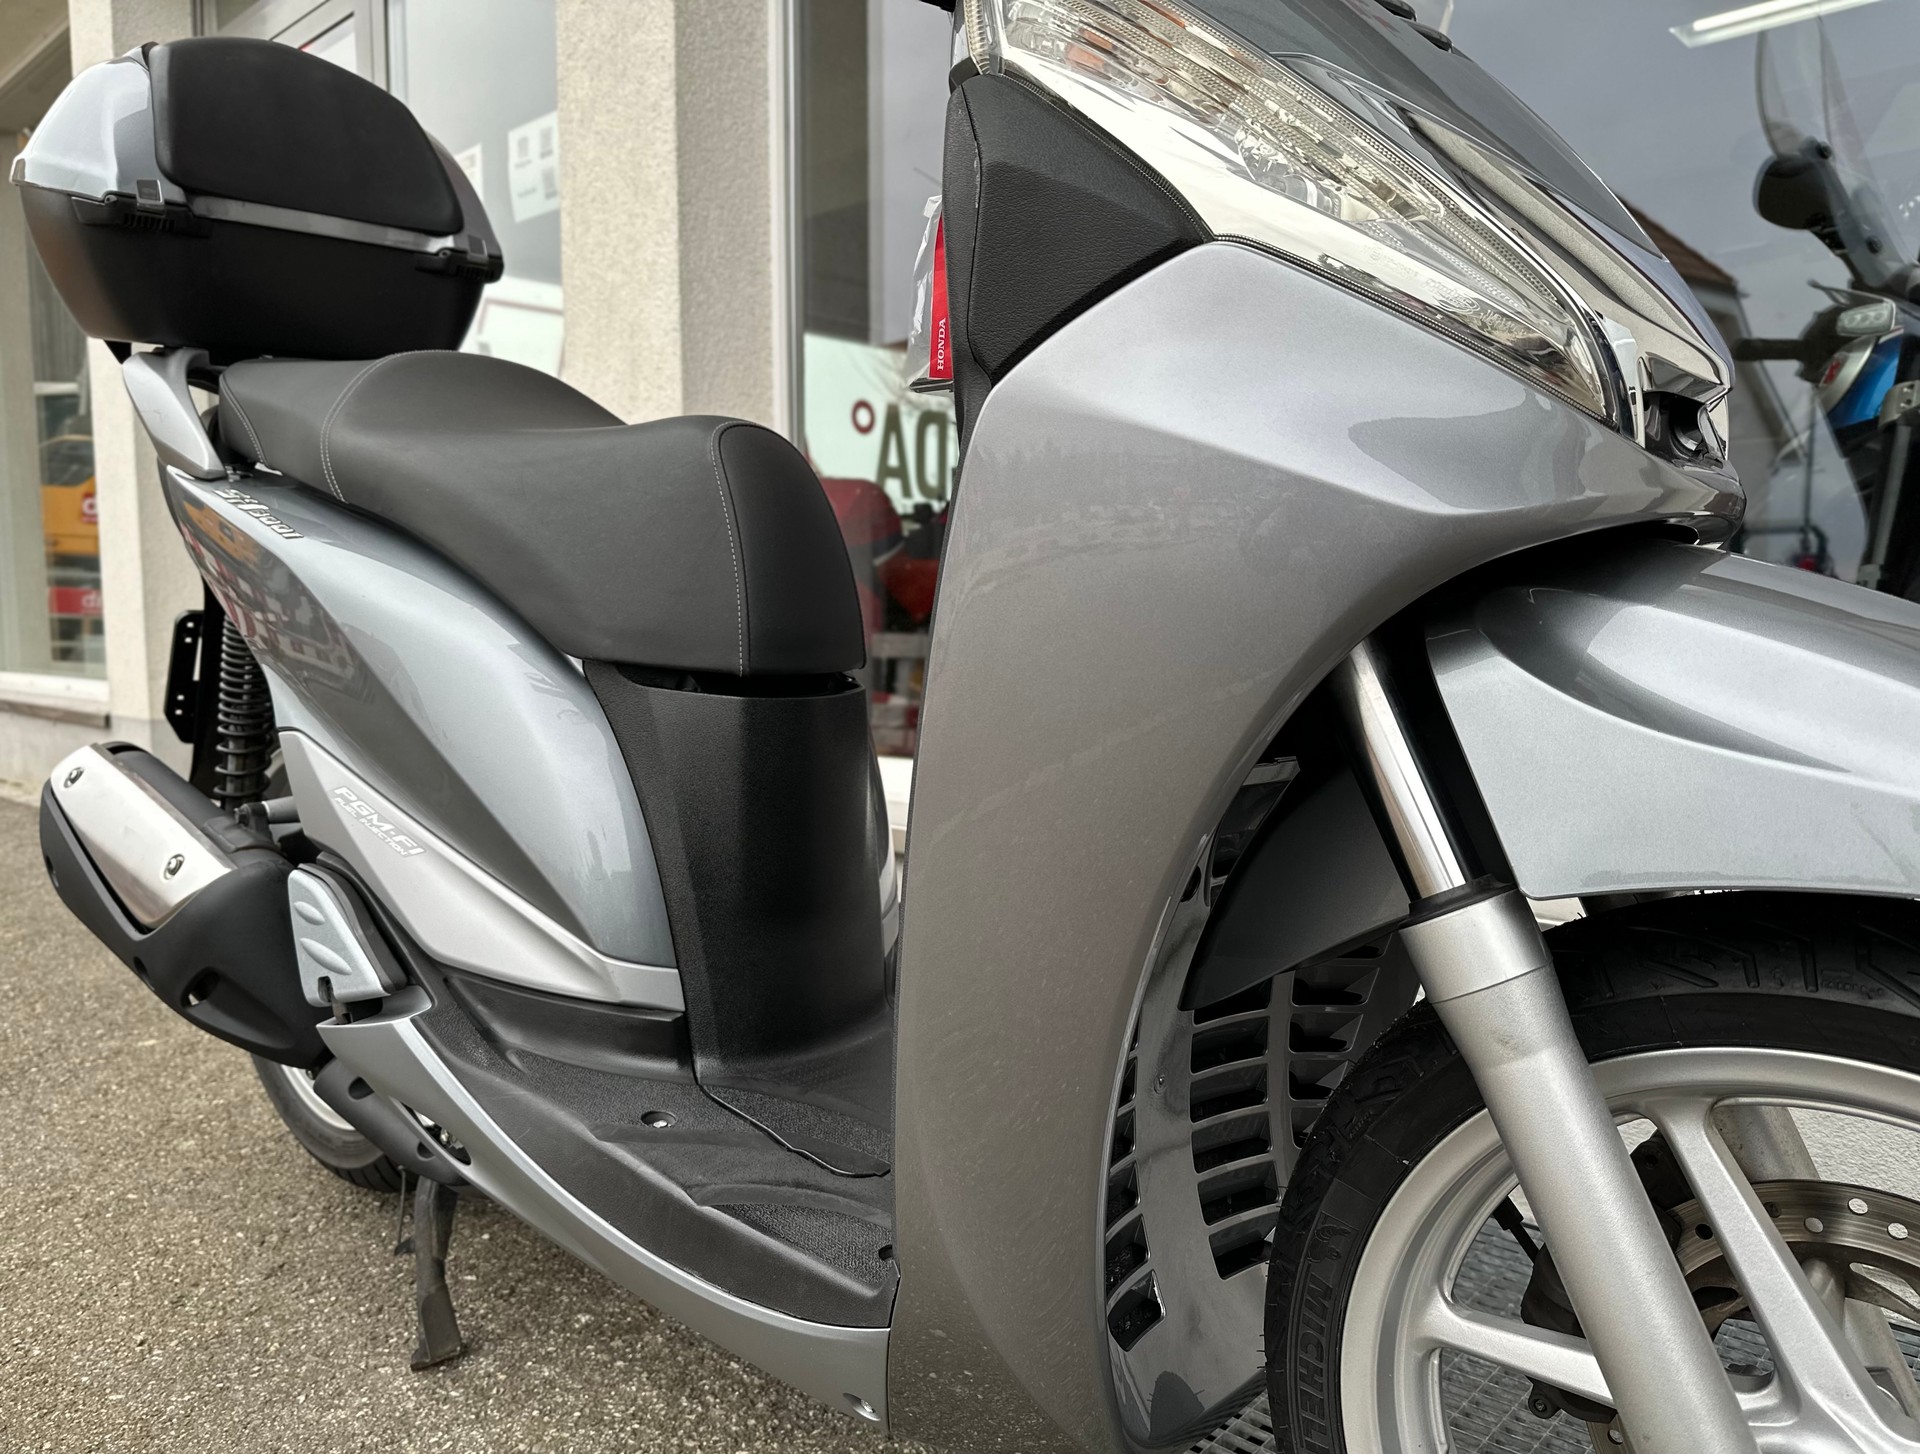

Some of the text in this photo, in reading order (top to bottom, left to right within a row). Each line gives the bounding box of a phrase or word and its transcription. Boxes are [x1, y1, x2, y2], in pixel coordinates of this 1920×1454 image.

[936, 317, 947, 370] HONDA
[333, 786, 425, 856] PGM-FI
[334, 797, 408, 856] FUEL INJECTION
